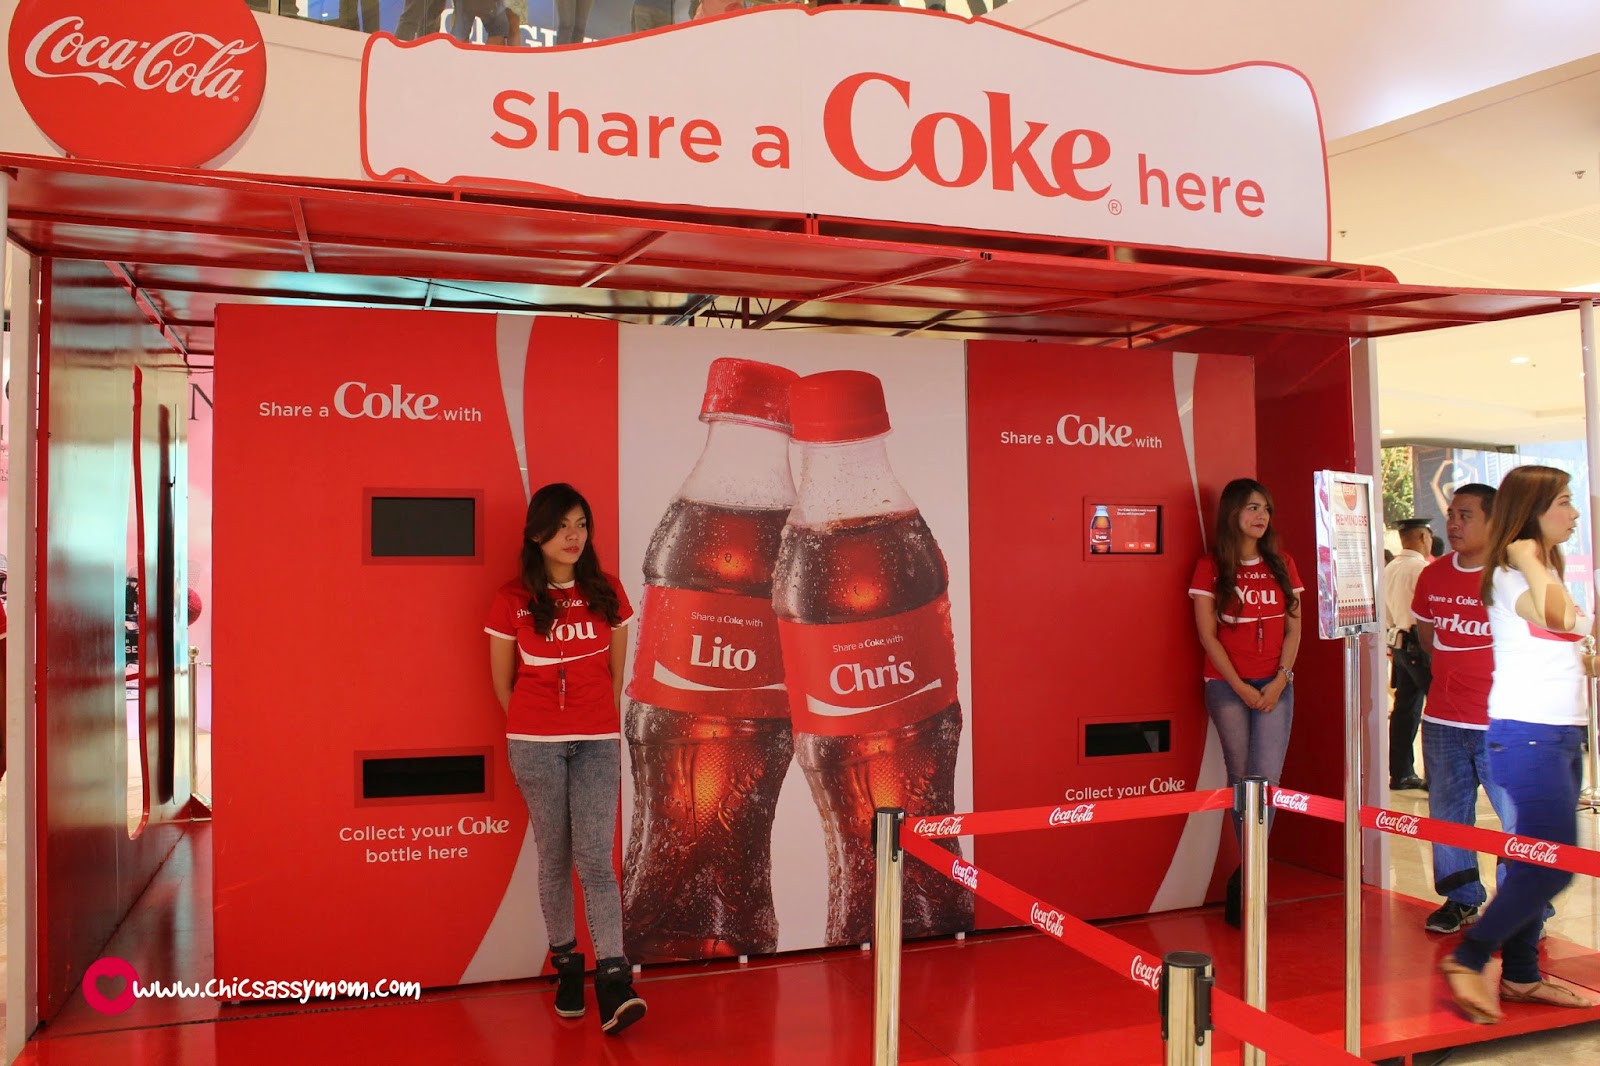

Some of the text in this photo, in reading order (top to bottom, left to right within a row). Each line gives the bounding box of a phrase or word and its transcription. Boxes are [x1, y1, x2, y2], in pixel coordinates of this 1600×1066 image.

[24, 15, 259, 100] Coca-Cola
[490, 71, 1266, 218] Share a Coke here
[259, 381, 482, 422] Share a Coke with
[1000, 414, 1162, 449] Share a Coke with
[1234, 585, 1278, 605] You
[1455, 595, 1478, 606] Coke
[691, 611, 715, 623] Share
[723, 615, 744, 626] Coke
[745, 618, 763, 627] with
[690, 634, 757, 672] Lito
[832, 634, 904, 653] Share a Coke with
[829, 655, 915, 695] Chris
[1065, 777, 1185, 801] Collect your Coke
[1272, 789, 1310, 812] Coca-Cola
[914, 815, 965, 837] Coca-Cola
[1049, 803, 1096, 826] Coca-Cola
[1375, 810, 1420, 835] Coca-Cola
[339, 816, 510, 842] Collect your Coke
[366, 845, 469, 863] bottle here
[1504, 836, 1560, 864] Coca-Cola
[951, 859, 978, 890] Coca-Cola
[1030, 901, 1065, 938] Coca-Cola
[1130, 954, 1163, 990] Coca-C
